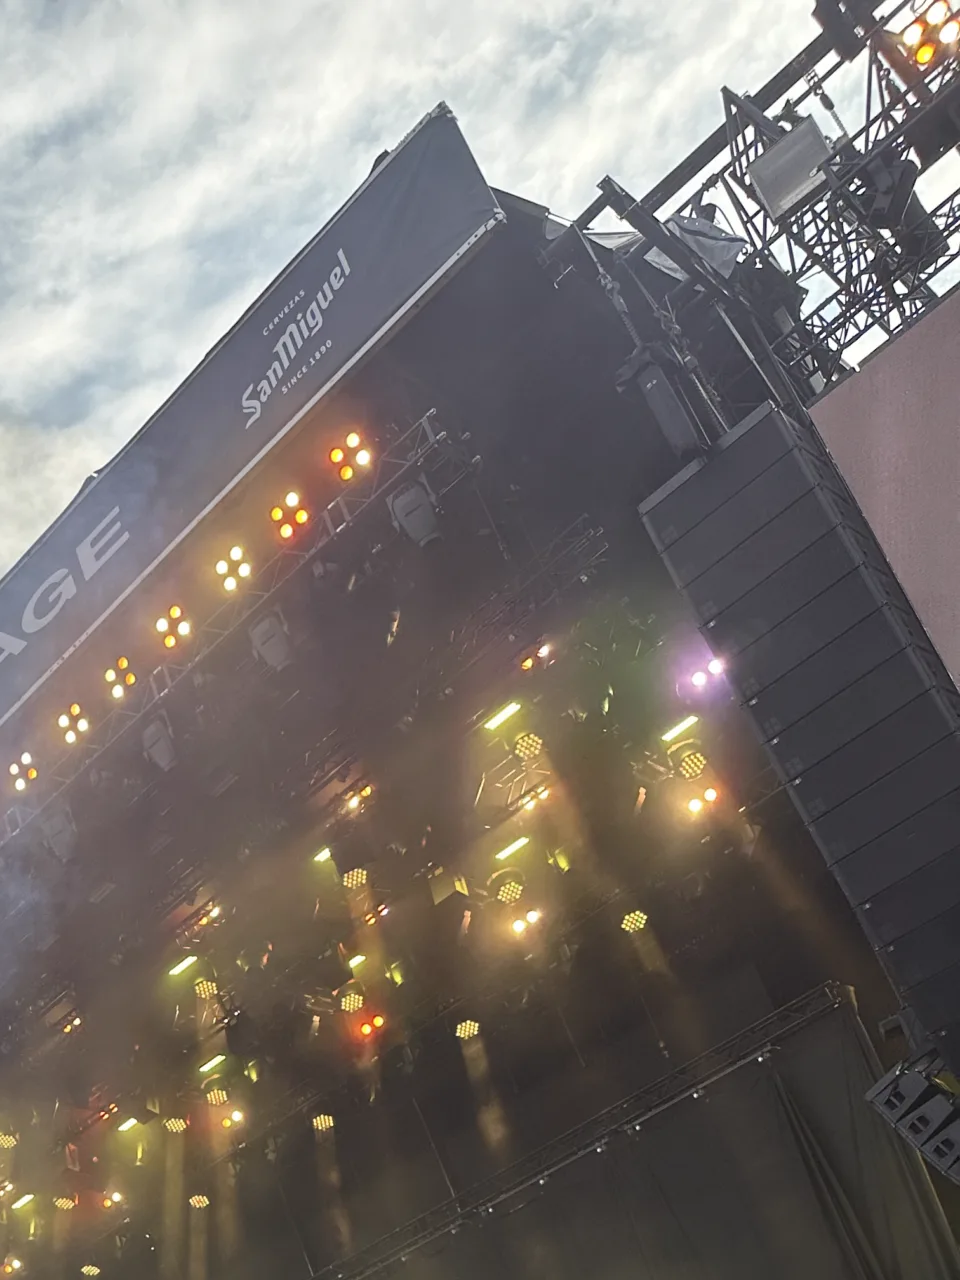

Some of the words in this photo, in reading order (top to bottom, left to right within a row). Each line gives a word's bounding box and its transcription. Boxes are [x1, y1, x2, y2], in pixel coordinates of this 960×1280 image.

[263, 289, 305, 335] CERVEZAS
[281, 361, 308, 394] SINCE
[309, 339, 333, 366] 1890
